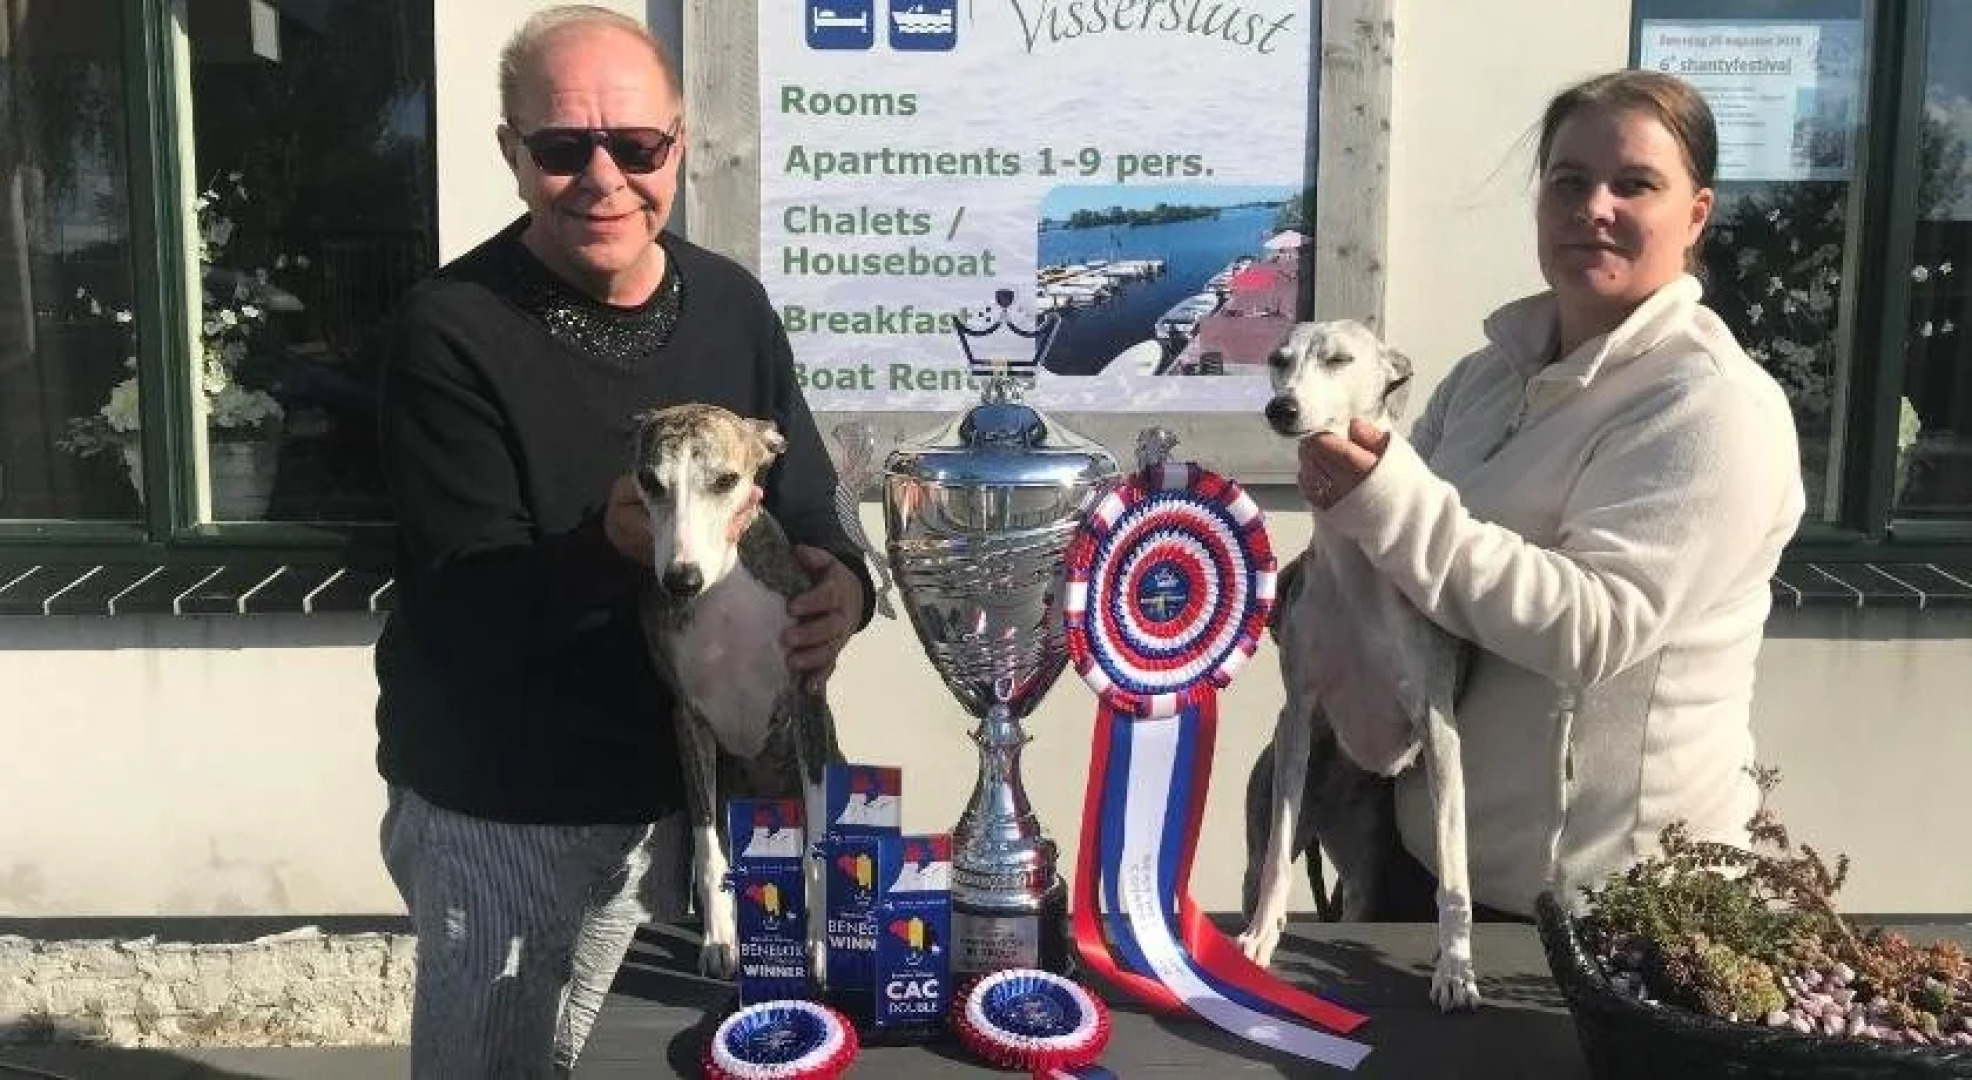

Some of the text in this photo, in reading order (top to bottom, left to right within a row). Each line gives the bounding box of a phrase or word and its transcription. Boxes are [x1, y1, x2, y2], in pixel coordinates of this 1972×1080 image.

[1010, 0, 1294, 54] Visserslust
[781, 86, 917, 116] Rooms
[784, 145, 1214, 182] Apartments 1-9 pers.
[783, 205, 966, 241] Chalets /
[782, 246, 996, 278] Houseboat
[783, 304, 973, 334] Breakfast
[829, 936, 877, 952] WINN
[744, 964, 806, 978] WINNER
[886, 978, 940, 1000] CAC
[889, 1001, 938, 1015] DOUBLE
